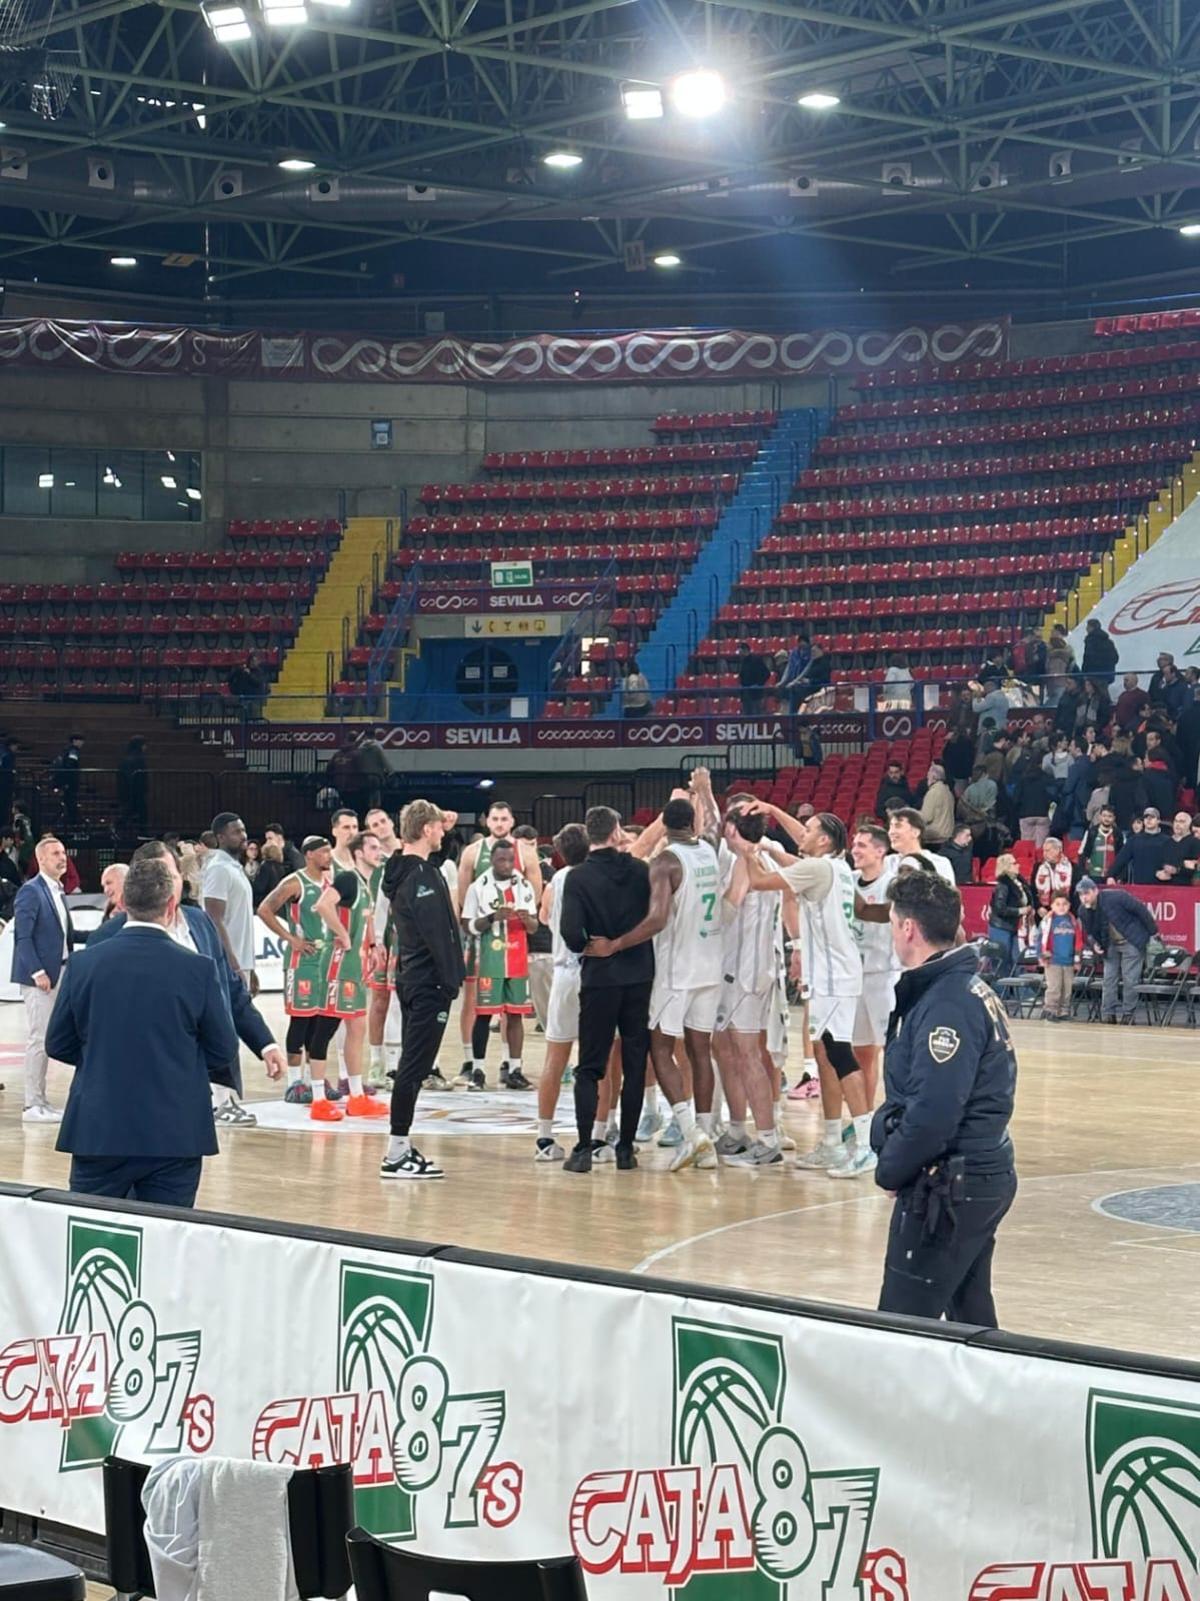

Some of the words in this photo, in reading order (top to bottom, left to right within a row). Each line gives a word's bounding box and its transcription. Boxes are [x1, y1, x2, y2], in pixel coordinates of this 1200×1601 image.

[489, 595, 543, 607] SEVILLA
[445, 727, 521, 744] SEVILLA
[715, 722, 784, 741] SEVILLA
[702, 893, 716, 921] 7
[1142, 901, 1177, 921] MD
[569, 1464, 756, 1585] CAJA
